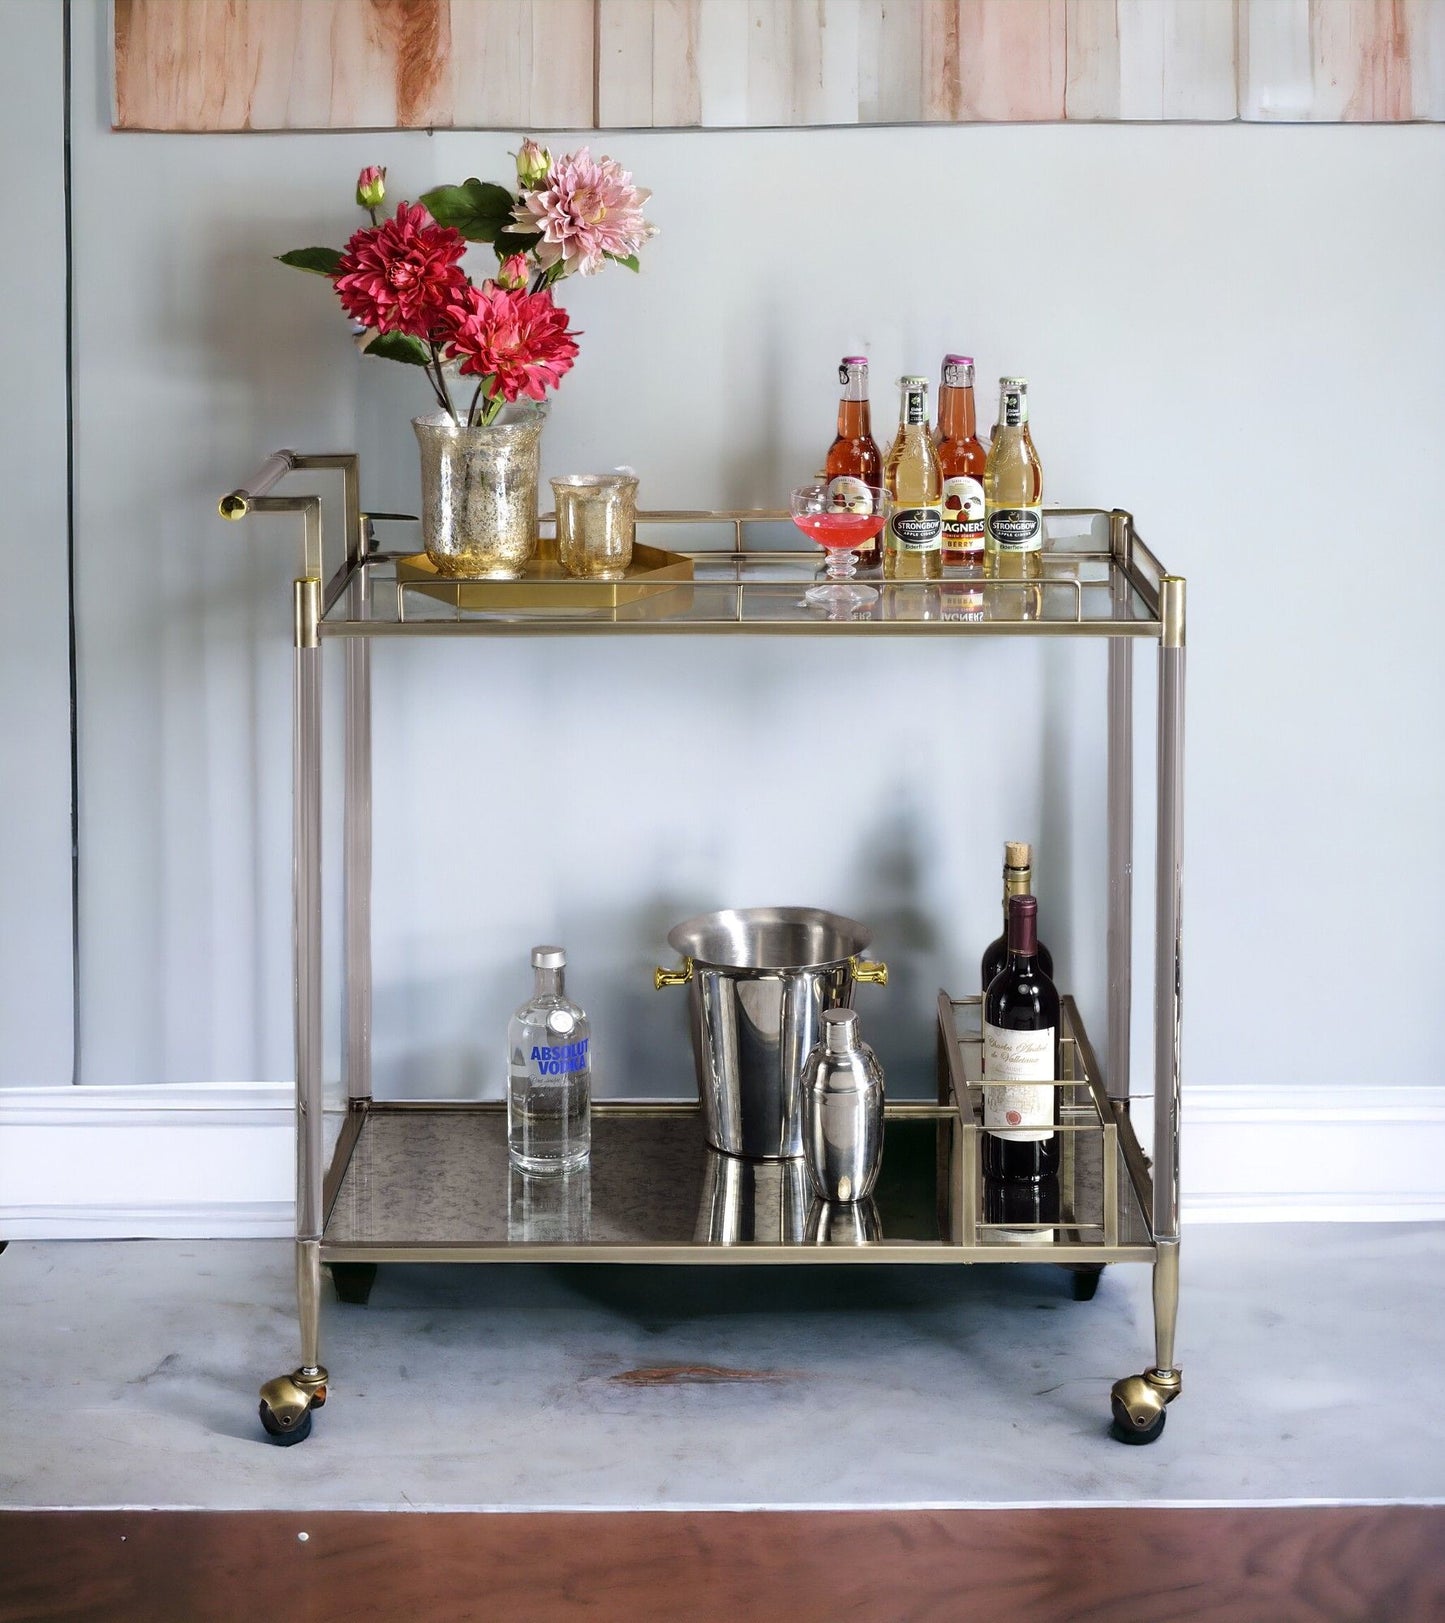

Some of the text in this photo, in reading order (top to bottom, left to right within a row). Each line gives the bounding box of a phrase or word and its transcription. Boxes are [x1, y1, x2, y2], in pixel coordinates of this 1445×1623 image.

[897, 521, 940, 530] STRONGBOW
[992, 521, 1037, 530] STRONGBOW
[947, 540, 974, 548] BERRY
[530, 1038, 589, 1061] ABSOLUT
[538, 1055, 586, 1075] VODKA
